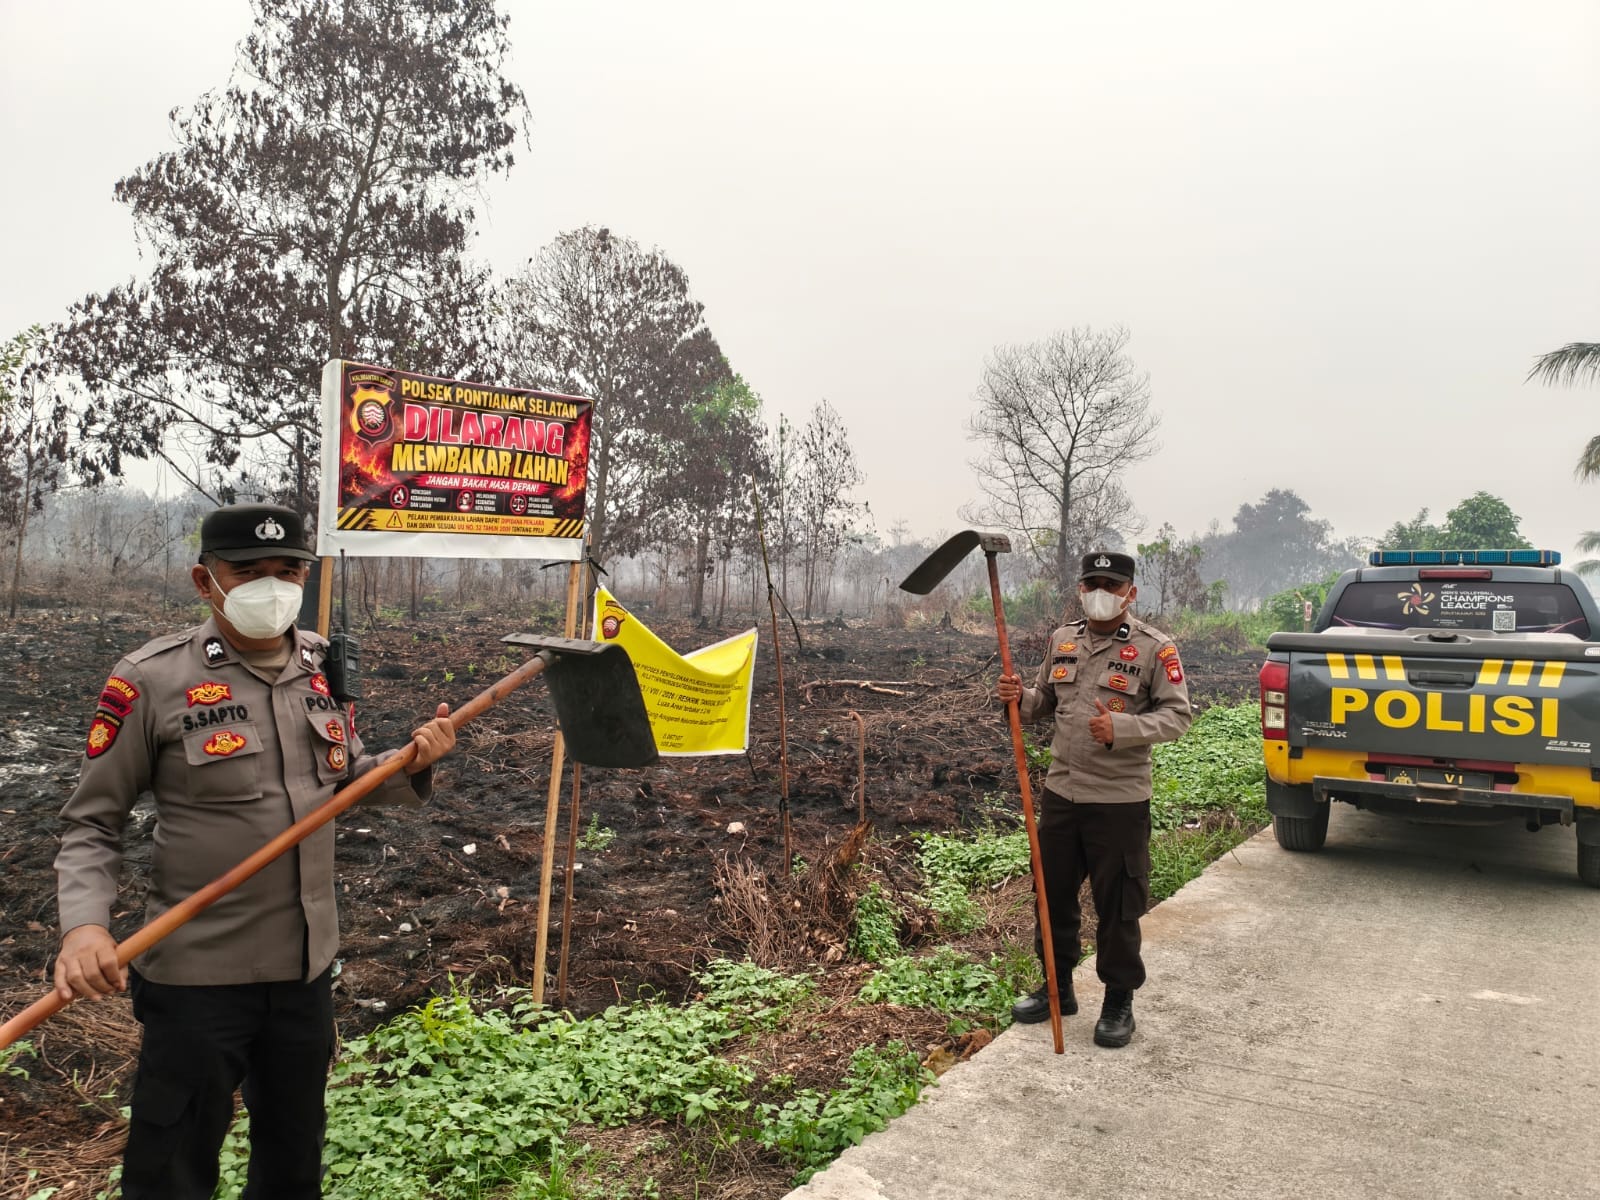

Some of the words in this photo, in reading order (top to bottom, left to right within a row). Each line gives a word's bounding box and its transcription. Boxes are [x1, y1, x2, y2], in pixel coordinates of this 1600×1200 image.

[401, 378, 452, 403] POLSEK
[455, 387, 526, 412] PONTIANAK
[529, 398, 577, 419] SELATAN
[403, 403, 565, 456] DILARANG
[391, 442, 512, 478] MEMBAKAR
[513, 452, 569, 486] LAHAN
[425, 475, 460, 488] JANGAN
[462, 477, 489, 490] BAKAR
[489, 480, 511, 491] MASA
[512, 481, 539, 493] DEPAN!
[407, 513, 429, 521] PELAKU
[429, 514, 466, 523] PEMBAKARAN
[466, 516, 484, 524] LAHAN
[485, 517, 500, 525] DAPAT
[418, 522, 436, 530] DENDA
[437, 523, 457, 531] SESUAI
[1440, 595, 1515, 603] CHAMPIONS
[1440, 602, 1488, 610] LEAGUE
[1107, 661, 1141, 677] POLRI
[182, 703, 249, 731] S.SAPTO
[1331, 687, 1559, 738] POLISI
[1304, 720, 1336, 729] ISUZU
